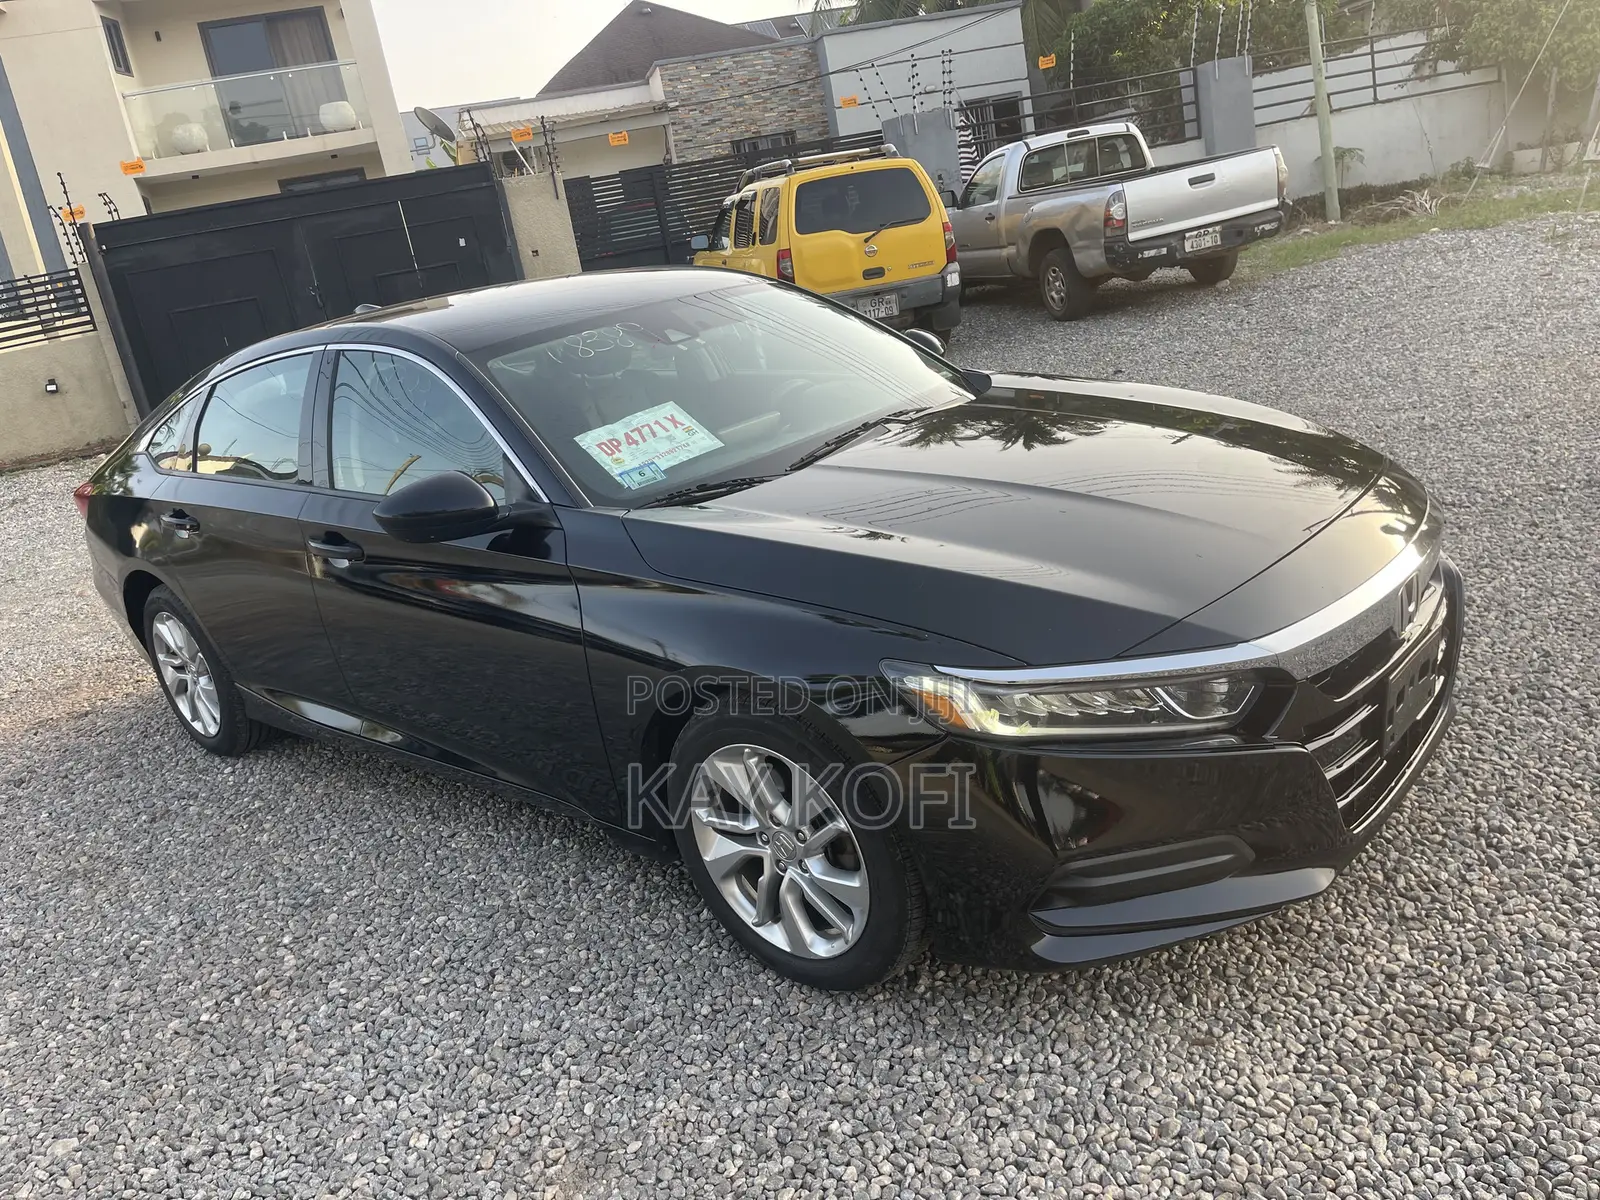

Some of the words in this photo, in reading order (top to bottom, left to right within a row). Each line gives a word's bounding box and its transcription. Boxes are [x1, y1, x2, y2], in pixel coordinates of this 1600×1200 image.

[870, 297, 884, 307] GR
[595, 437, 623, 457] DP
[623, 419, 671, 447] 4771
[663, 413, 686, 430] X
[638, 470, 646, 478] 6
